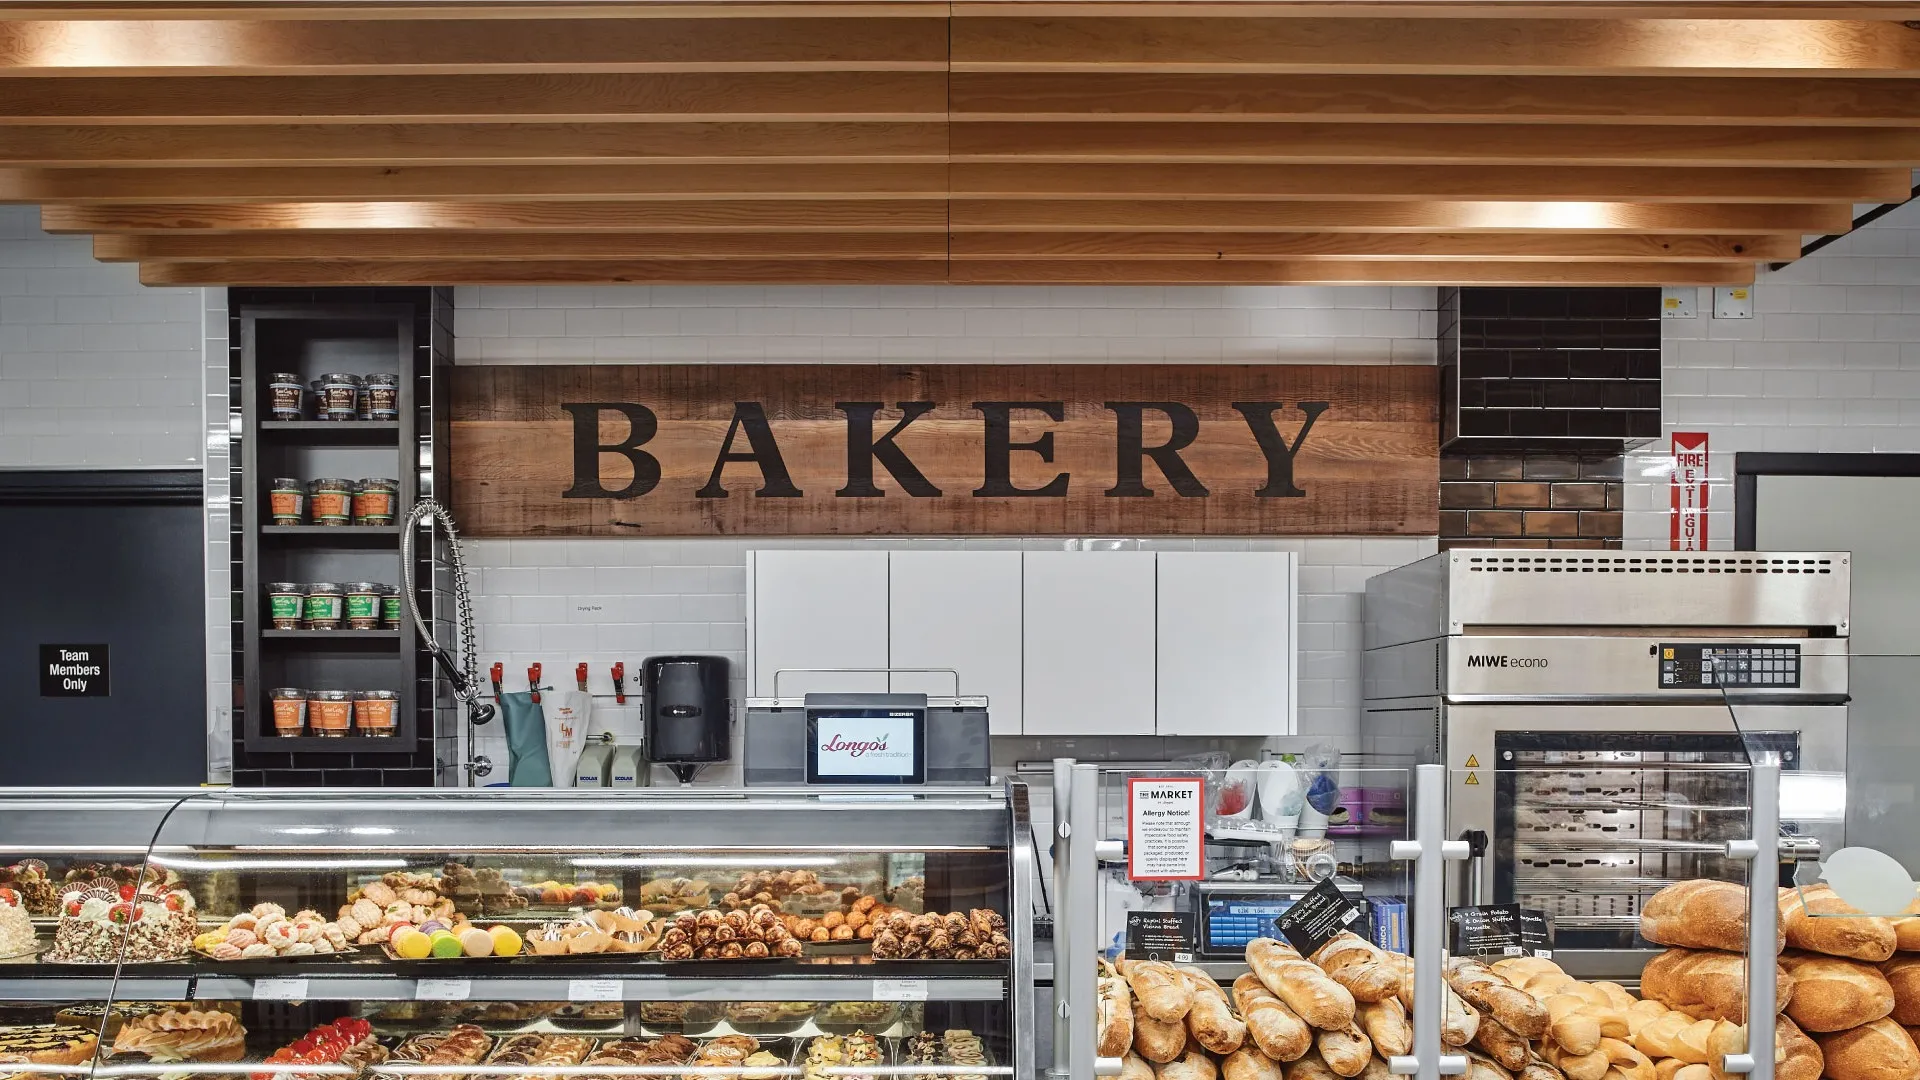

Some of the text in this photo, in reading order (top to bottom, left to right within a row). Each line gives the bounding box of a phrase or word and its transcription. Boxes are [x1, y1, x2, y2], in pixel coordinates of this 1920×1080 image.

[560, 401, 1330, 498] BAKERY
[1676, 454, 1704, 467] FIRE
[60, 650, 89, 661] Team
[1467, 655, 1548, 667] MIWE econo
[50, 664, 100, 676] Members
[63, 678, 87, 692] Only
